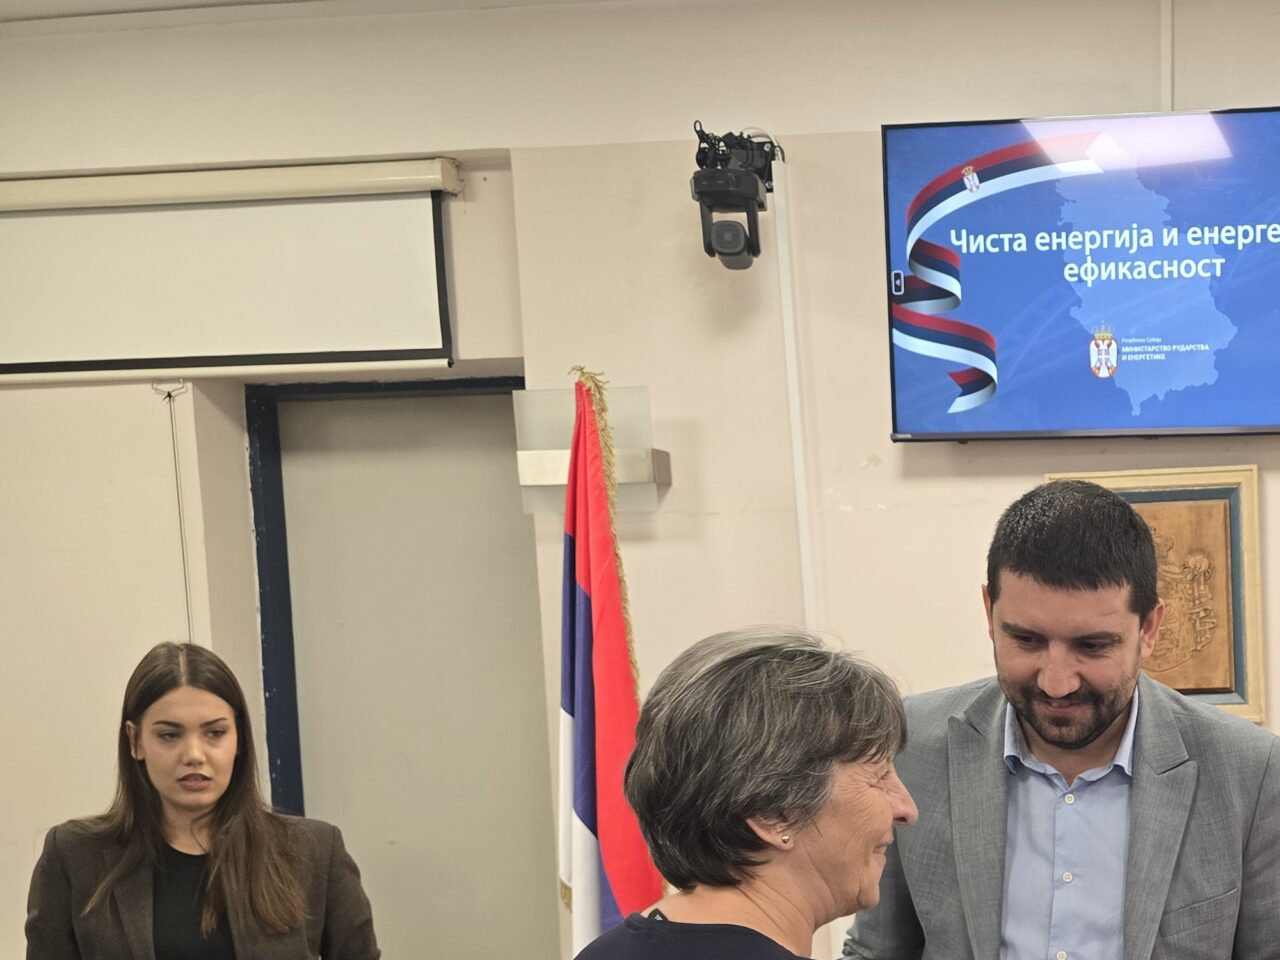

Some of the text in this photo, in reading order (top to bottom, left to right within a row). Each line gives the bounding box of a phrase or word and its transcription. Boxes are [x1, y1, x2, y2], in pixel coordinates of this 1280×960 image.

[949, 229, 1027, 254] Чиста
[1035, 223, 1154, 256] енергија
[1162, 227, 1179, 247] и
[1063, 257, 1226, 287] ефикасност
